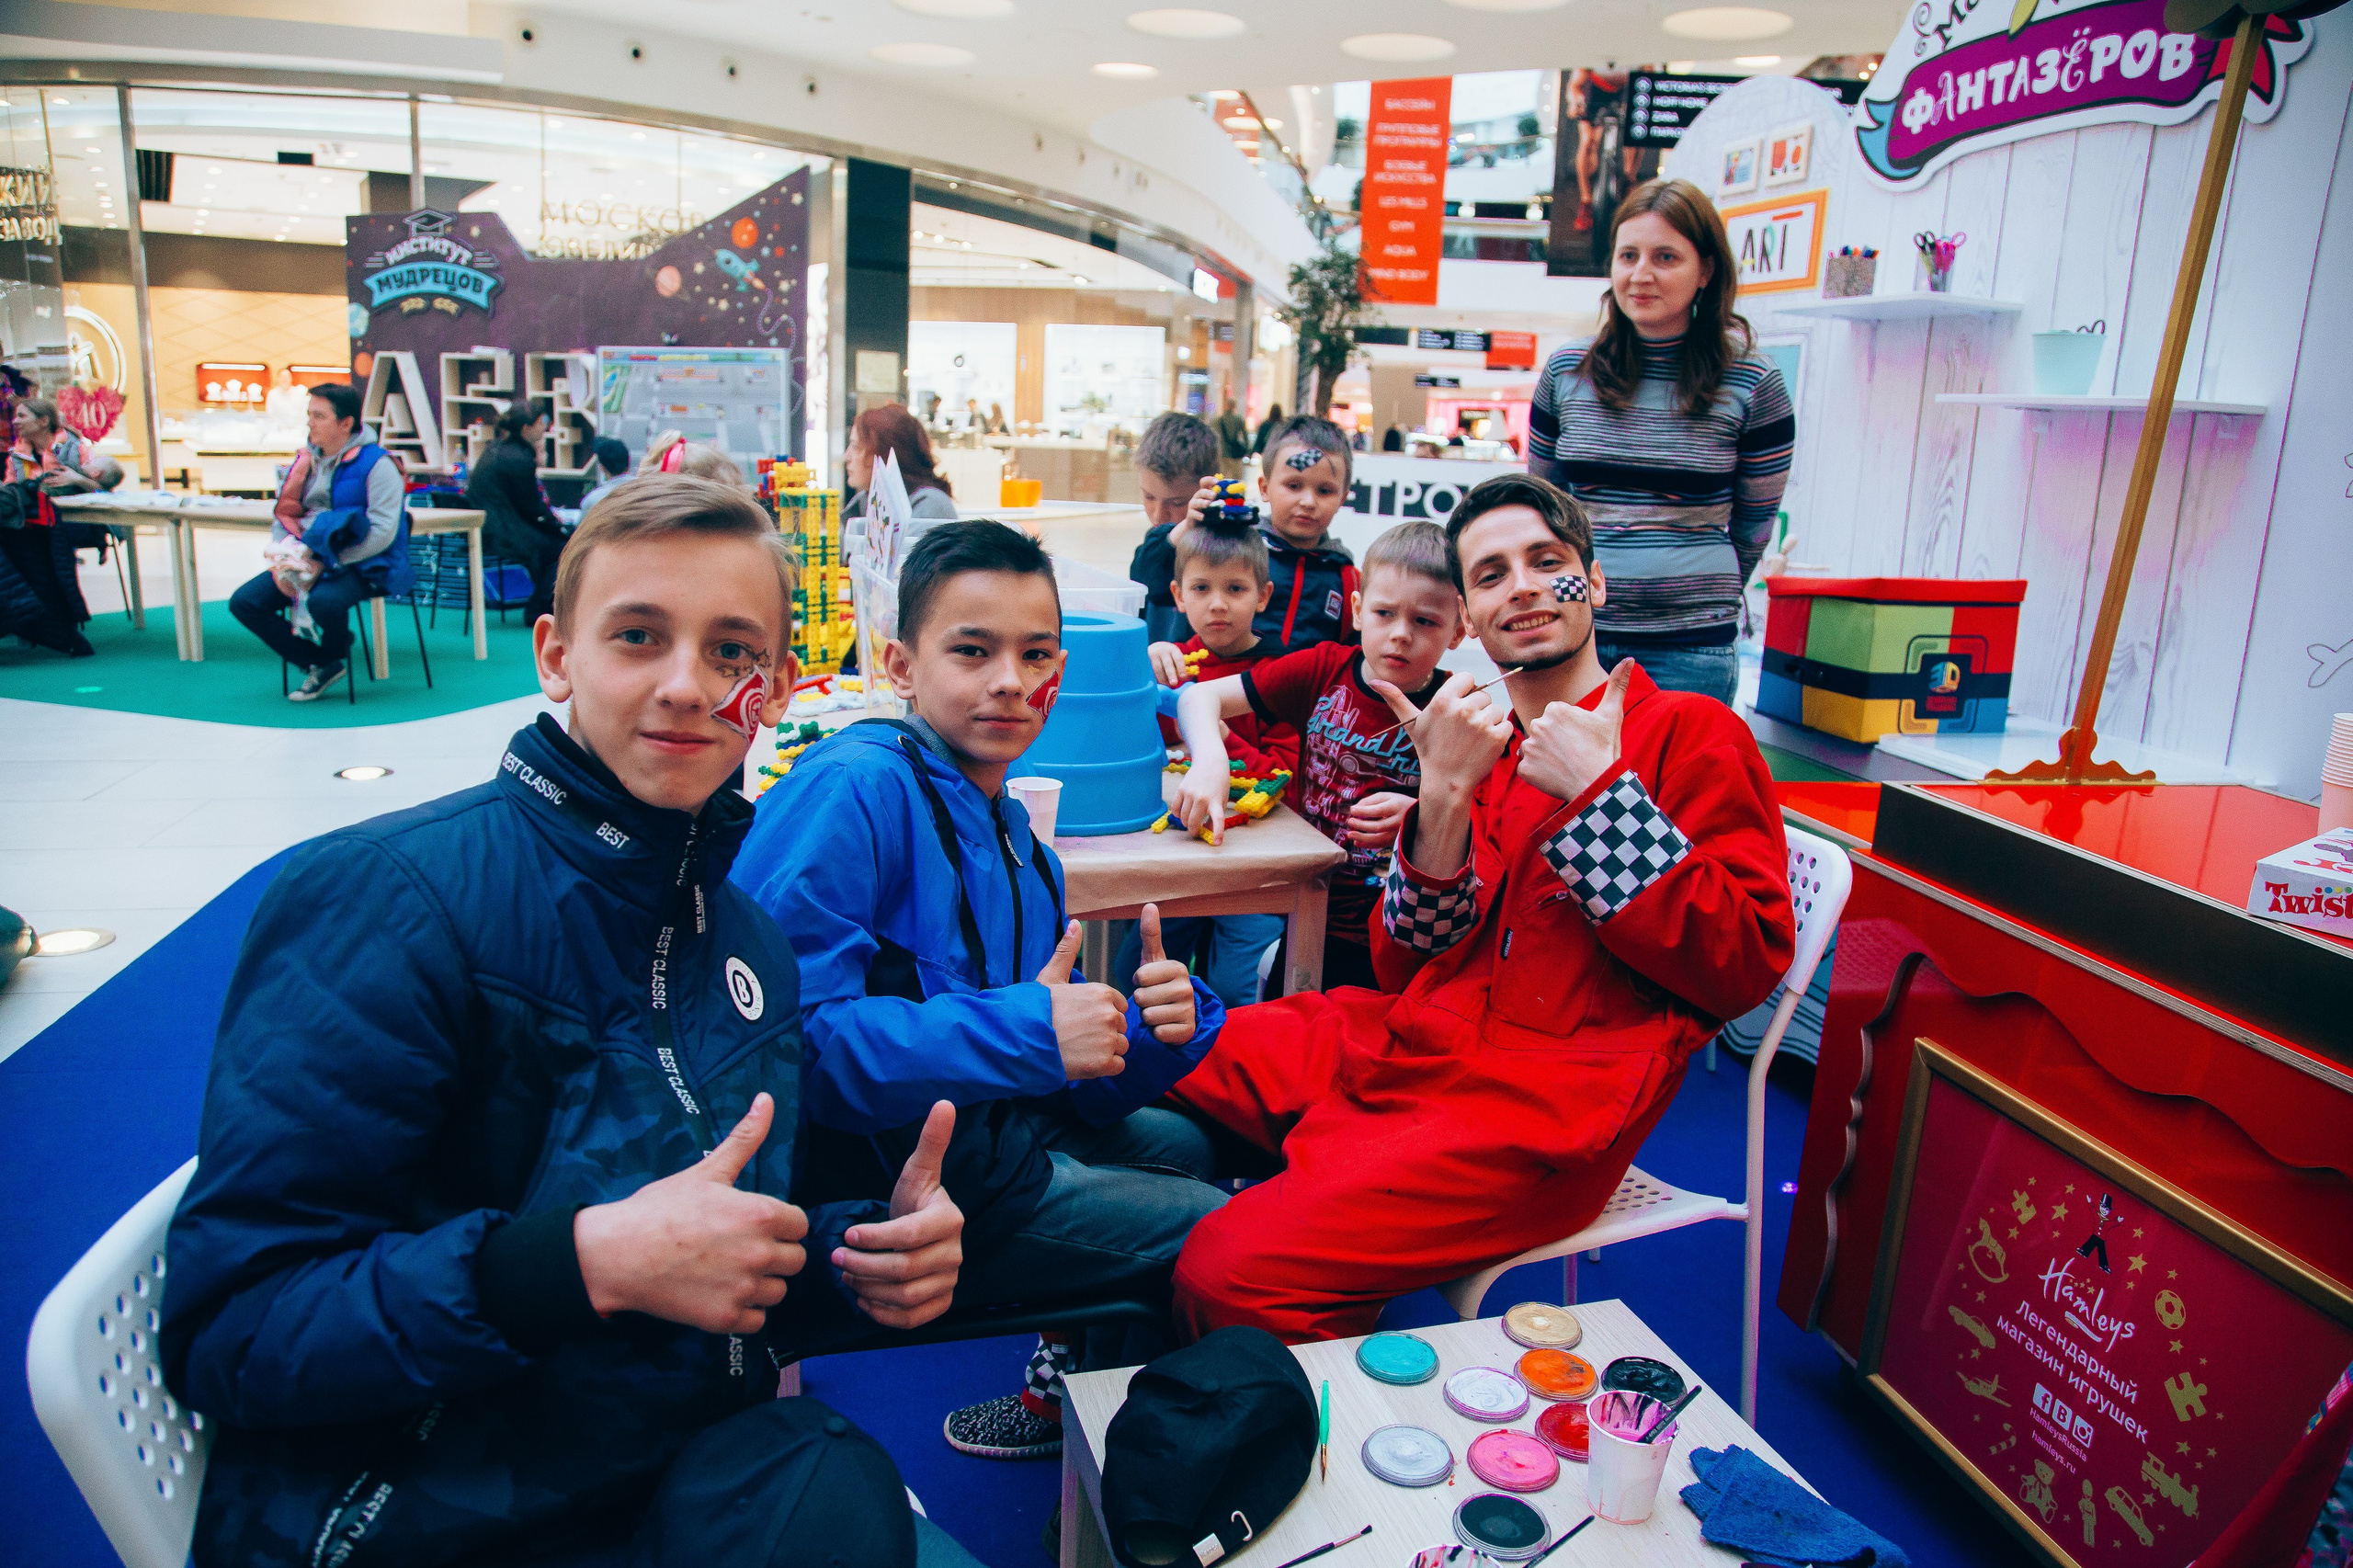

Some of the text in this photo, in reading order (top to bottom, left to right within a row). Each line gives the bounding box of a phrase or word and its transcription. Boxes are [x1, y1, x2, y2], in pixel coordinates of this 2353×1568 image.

[1902, 26, 2196, 135] ФАНТАЗЁРОВ
[1739, 210, 1803, 274] ART
[376, 267, 483, 293] МУДРЕЦОВ
[1306, 696, 1391, 756] Grand
[596, 822, 630, 849] BEST
[2038, 1256, 2136, 1354] Hamleys
[1996, 1315, 2149, 1445] магазин игрушек
[2016, 1300, 2138, 1404] Легендарный
[2029, 1407, 2087, 1462] HamleysRussia
[2031, 1430, 2076, 1475] hamleys.ru
